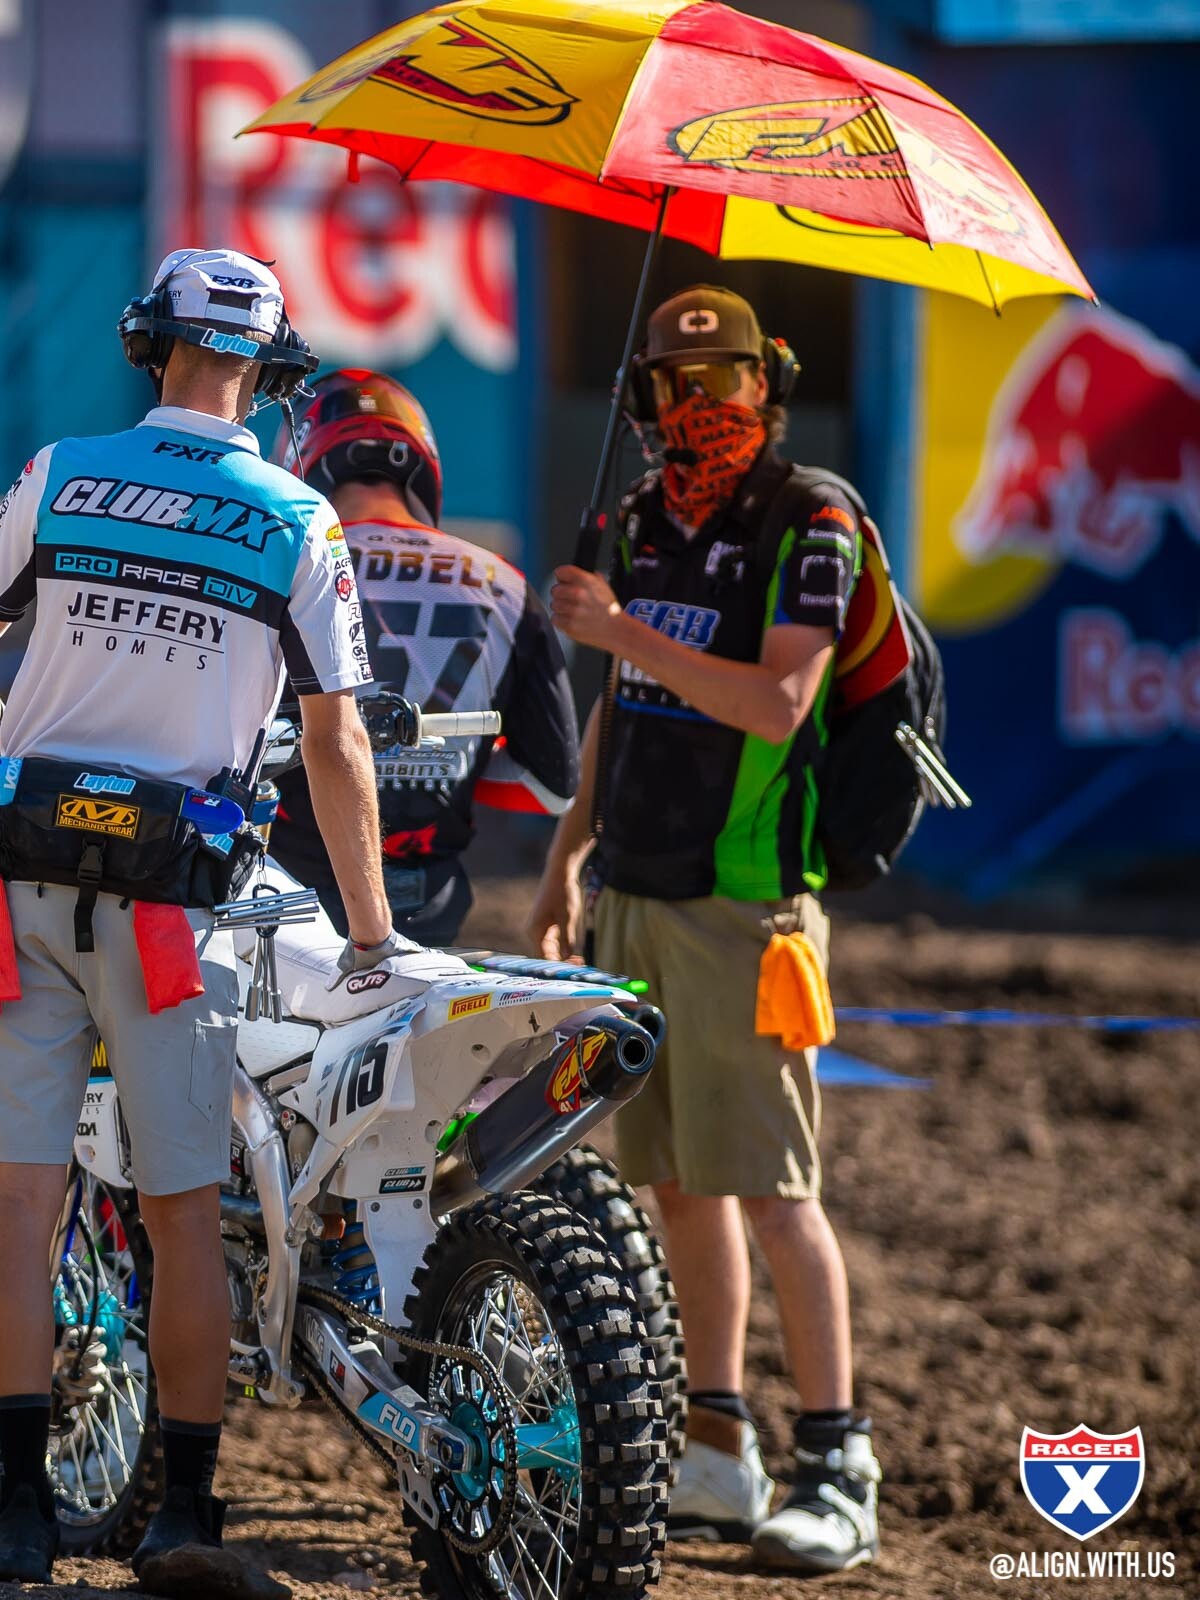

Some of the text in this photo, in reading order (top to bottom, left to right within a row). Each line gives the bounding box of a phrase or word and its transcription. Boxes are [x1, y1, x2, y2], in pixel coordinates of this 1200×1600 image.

[211, 275, 256, 289] FXR
[200, 328, 260, 358] Layton
[152, 441, 223, 465] FXR
[49, 475, 296, 554] CLUBMX
[59, 555, 257, 605] PRO RACE DIV
[67, 592, 227, 644] JEFFERY
[72, 631, 208, 671] HOMES
[74, 772, 136, 796] Layton
[59, 815, 134, 837] MECHANIX WEAR
[347, 972, 387, 993] GUTS
[452, 993, 491, 1016] PIRELLI
[378, 1402, 417, 1444] FLO
